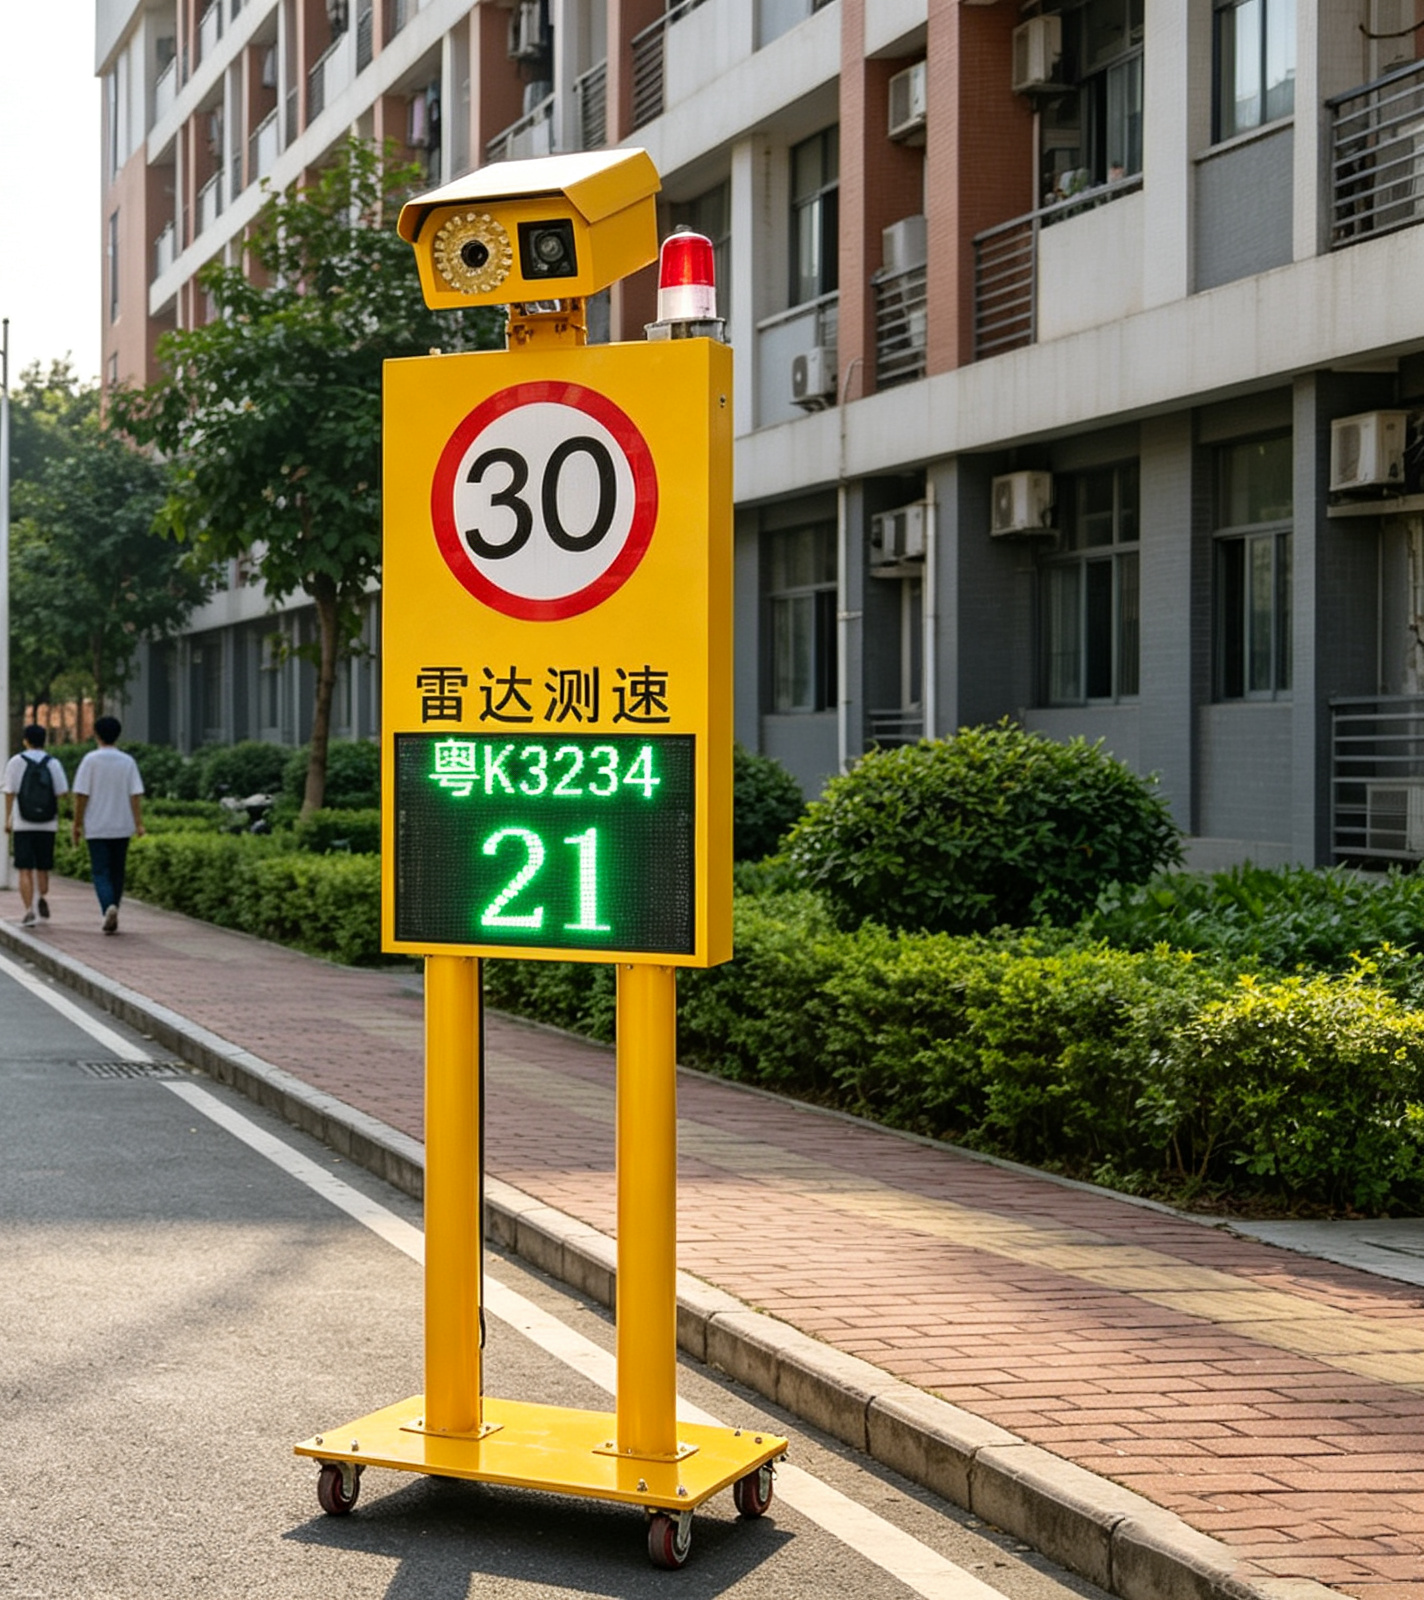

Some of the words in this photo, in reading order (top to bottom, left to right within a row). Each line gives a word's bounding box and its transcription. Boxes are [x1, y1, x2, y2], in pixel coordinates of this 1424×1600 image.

[465, 436, 617, 560] 30
[416, 665, 671, 724] 雷达测速
[428, 738, 661, 799] 粤K3234
[480, 826, 612, 931] 21
